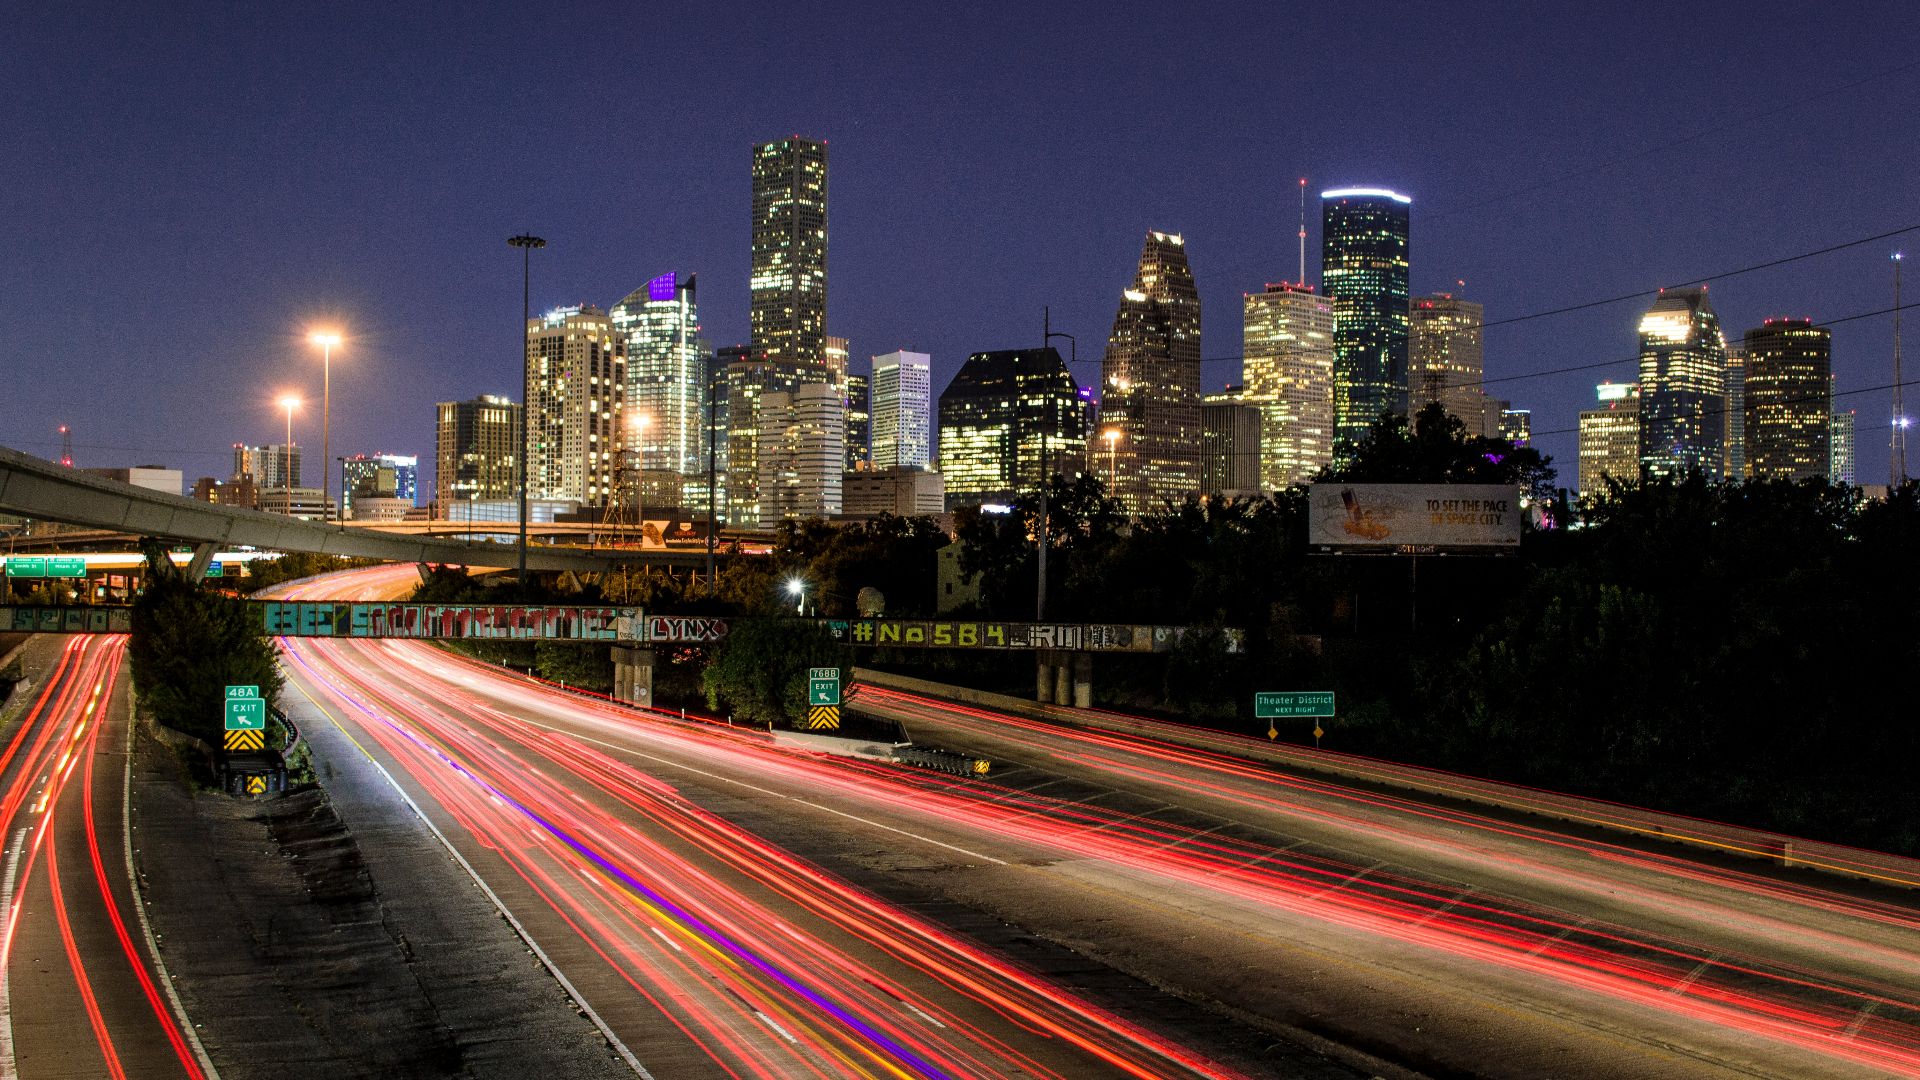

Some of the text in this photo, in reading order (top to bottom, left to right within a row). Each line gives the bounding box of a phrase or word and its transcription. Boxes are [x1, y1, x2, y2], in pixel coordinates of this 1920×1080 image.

[1426, 500, 1508, 513] TO SET THE PACE
[1431, 512, 1443, 525] IN
[1446, 513, 1476, 525] SPACE
[651, 618, 720, 641] LYNX
[814, 669, 836, 678] 768B
[228, 687, 255, 697] 48A
[233, 704, 257, 712] EXIT
